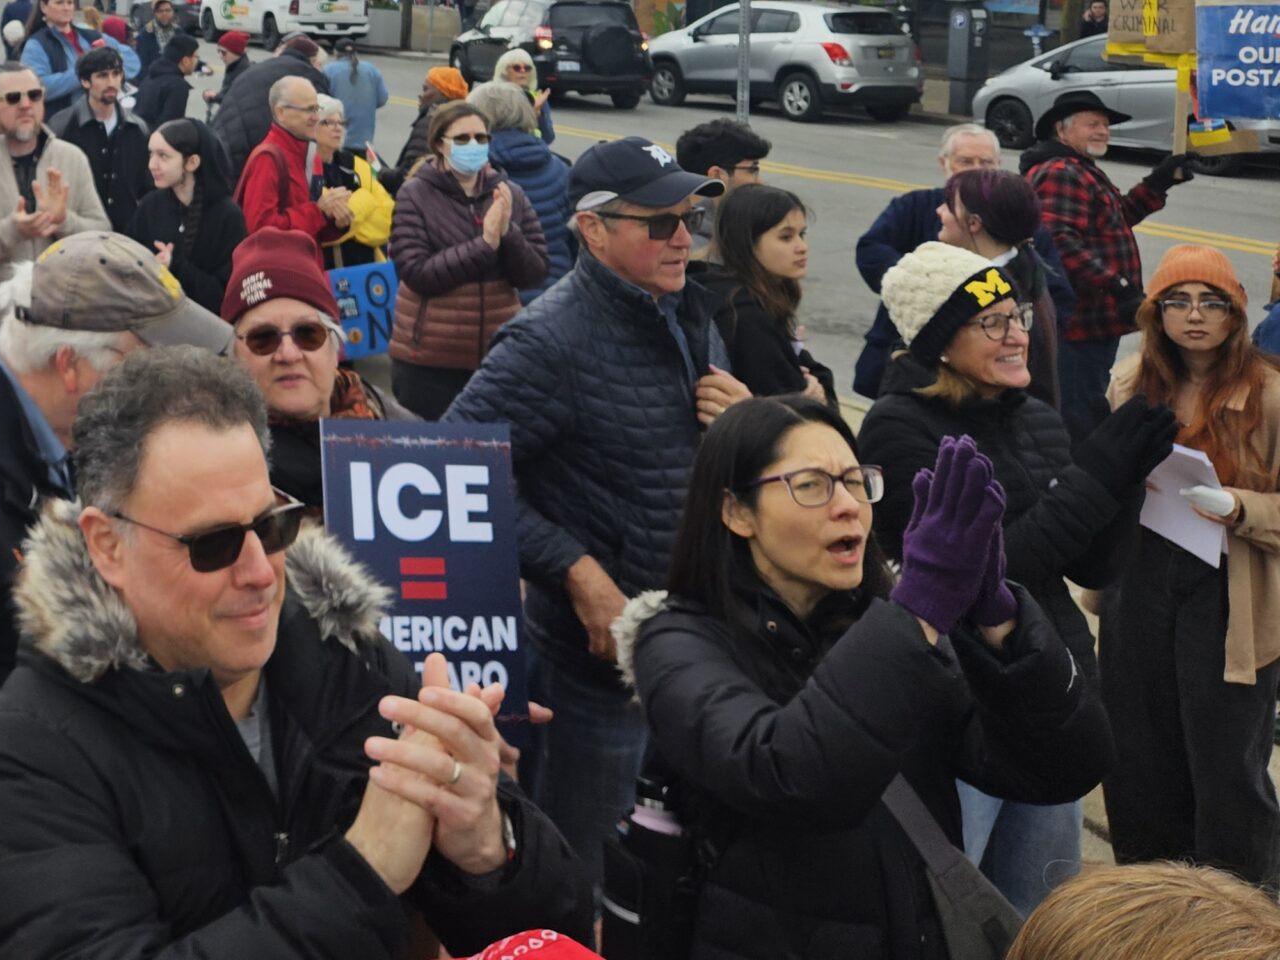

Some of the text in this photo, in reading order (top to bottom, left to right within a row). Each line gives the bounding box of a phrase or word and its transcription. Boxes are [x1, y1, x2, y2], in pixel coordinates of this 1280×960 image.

[1114, 14, 1177, 35] CRIMINAL
[1228, 7, 1280, 35] Han
[240, 278, 273, 300] NATIONAL
[247, 290, 267, 306] PARK
[964, 268, 1012, 308] M
[349, 461, 494, 542] ICE
